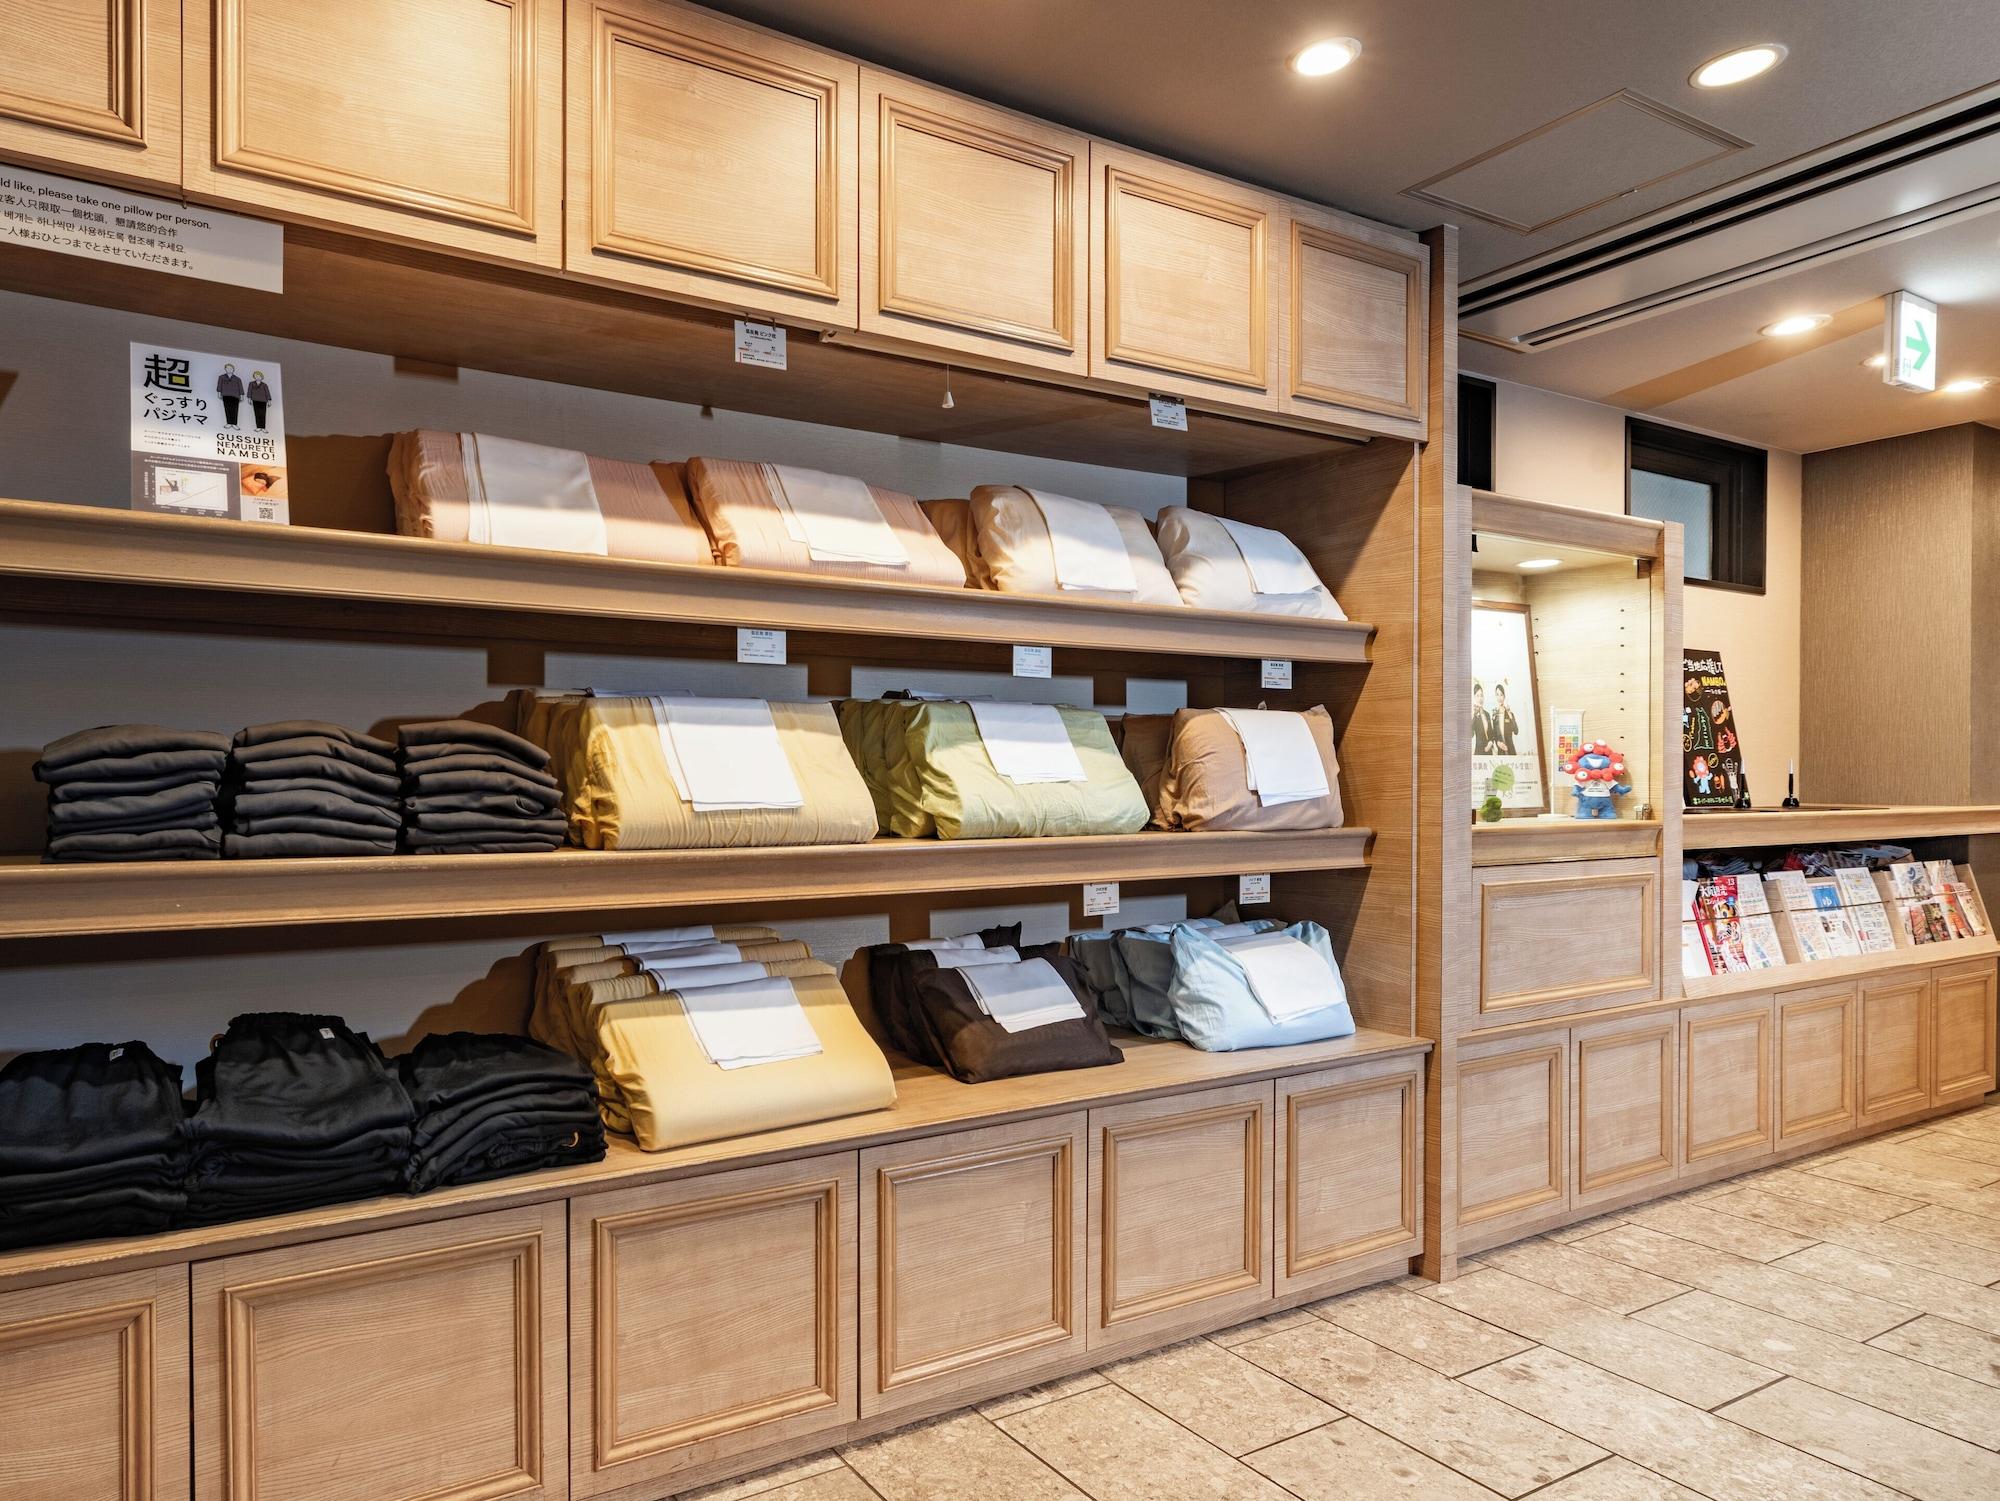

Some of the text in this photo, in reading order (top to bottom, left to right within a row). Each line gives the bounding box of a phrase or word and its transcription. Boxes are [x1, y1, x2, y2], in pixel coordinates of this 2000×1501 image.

[14, 180, 35, 194] like,
[38, 187, 73, 201] please
[76, 194, 99, 206] take
[101, 201, 121, 211] one
[123, 205, 153, 217] pillow
[156, 212, 172, 222] per
[175, 216, 212, 230] person.
[143, 354, 193, 393] 超
[144, 392, 207, 411] ぐっすり
[143, 407, 208, 425] パジャマ
[216, 433, 275, 446] GUSSURI
[216, 441, 275, 453] NEMURETE
[217, 447, 275, 461] NAMBO!
